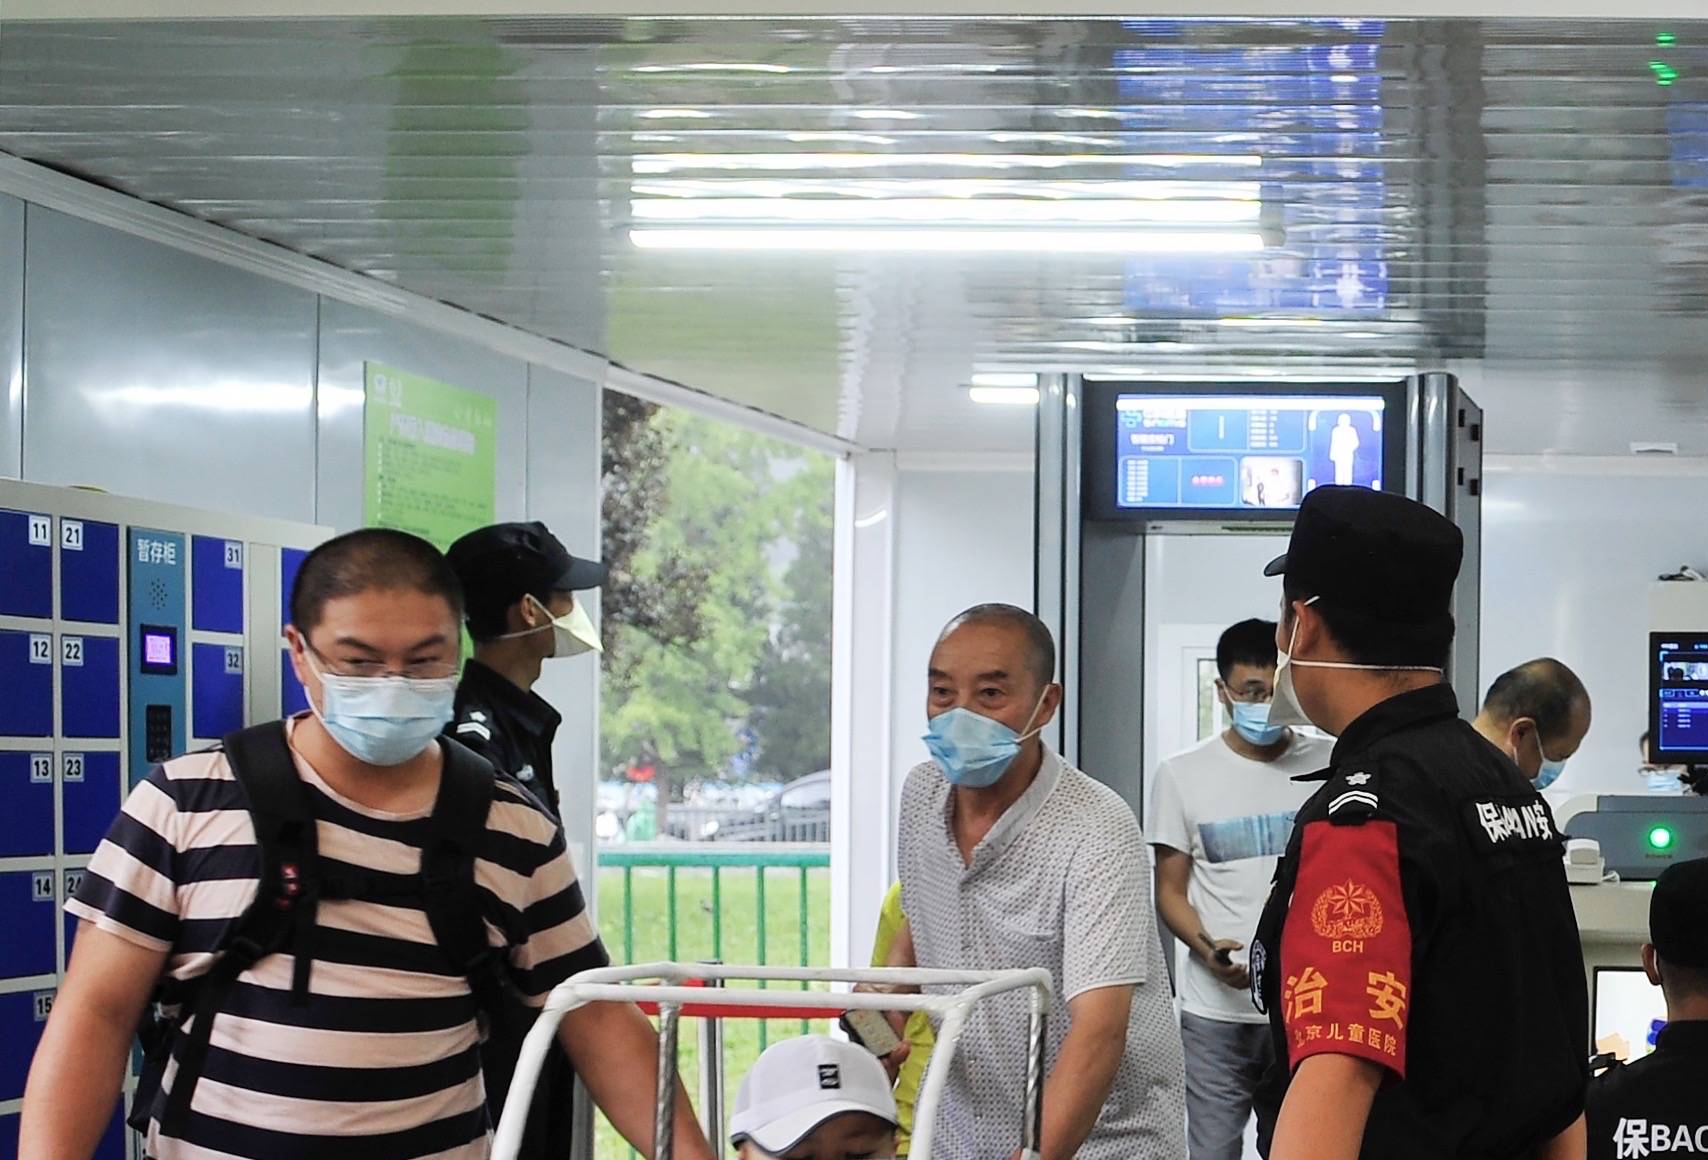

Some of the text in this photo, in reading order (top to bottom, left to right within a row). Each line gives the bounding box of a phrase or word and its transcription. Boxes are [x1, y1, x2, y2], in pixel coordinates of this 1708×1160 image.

[33, 522, 47, 539] 11
[65, 527, 80, 544] 21
[137, 539, 176, 565] 暂存柜
[227, 545, 240, 563] 31
[33, 641, 48, 658] 12
[65, 643, 80, 660] 22
[227, 652, 240, 669] 32
[34, 760, 49, 776] 13
[66, 759, 81, 776] 23
[36, 879, 51, 895] 14
[1332, 940, 1364, 953] BCH
[38, 998, 52, 1015] 15
